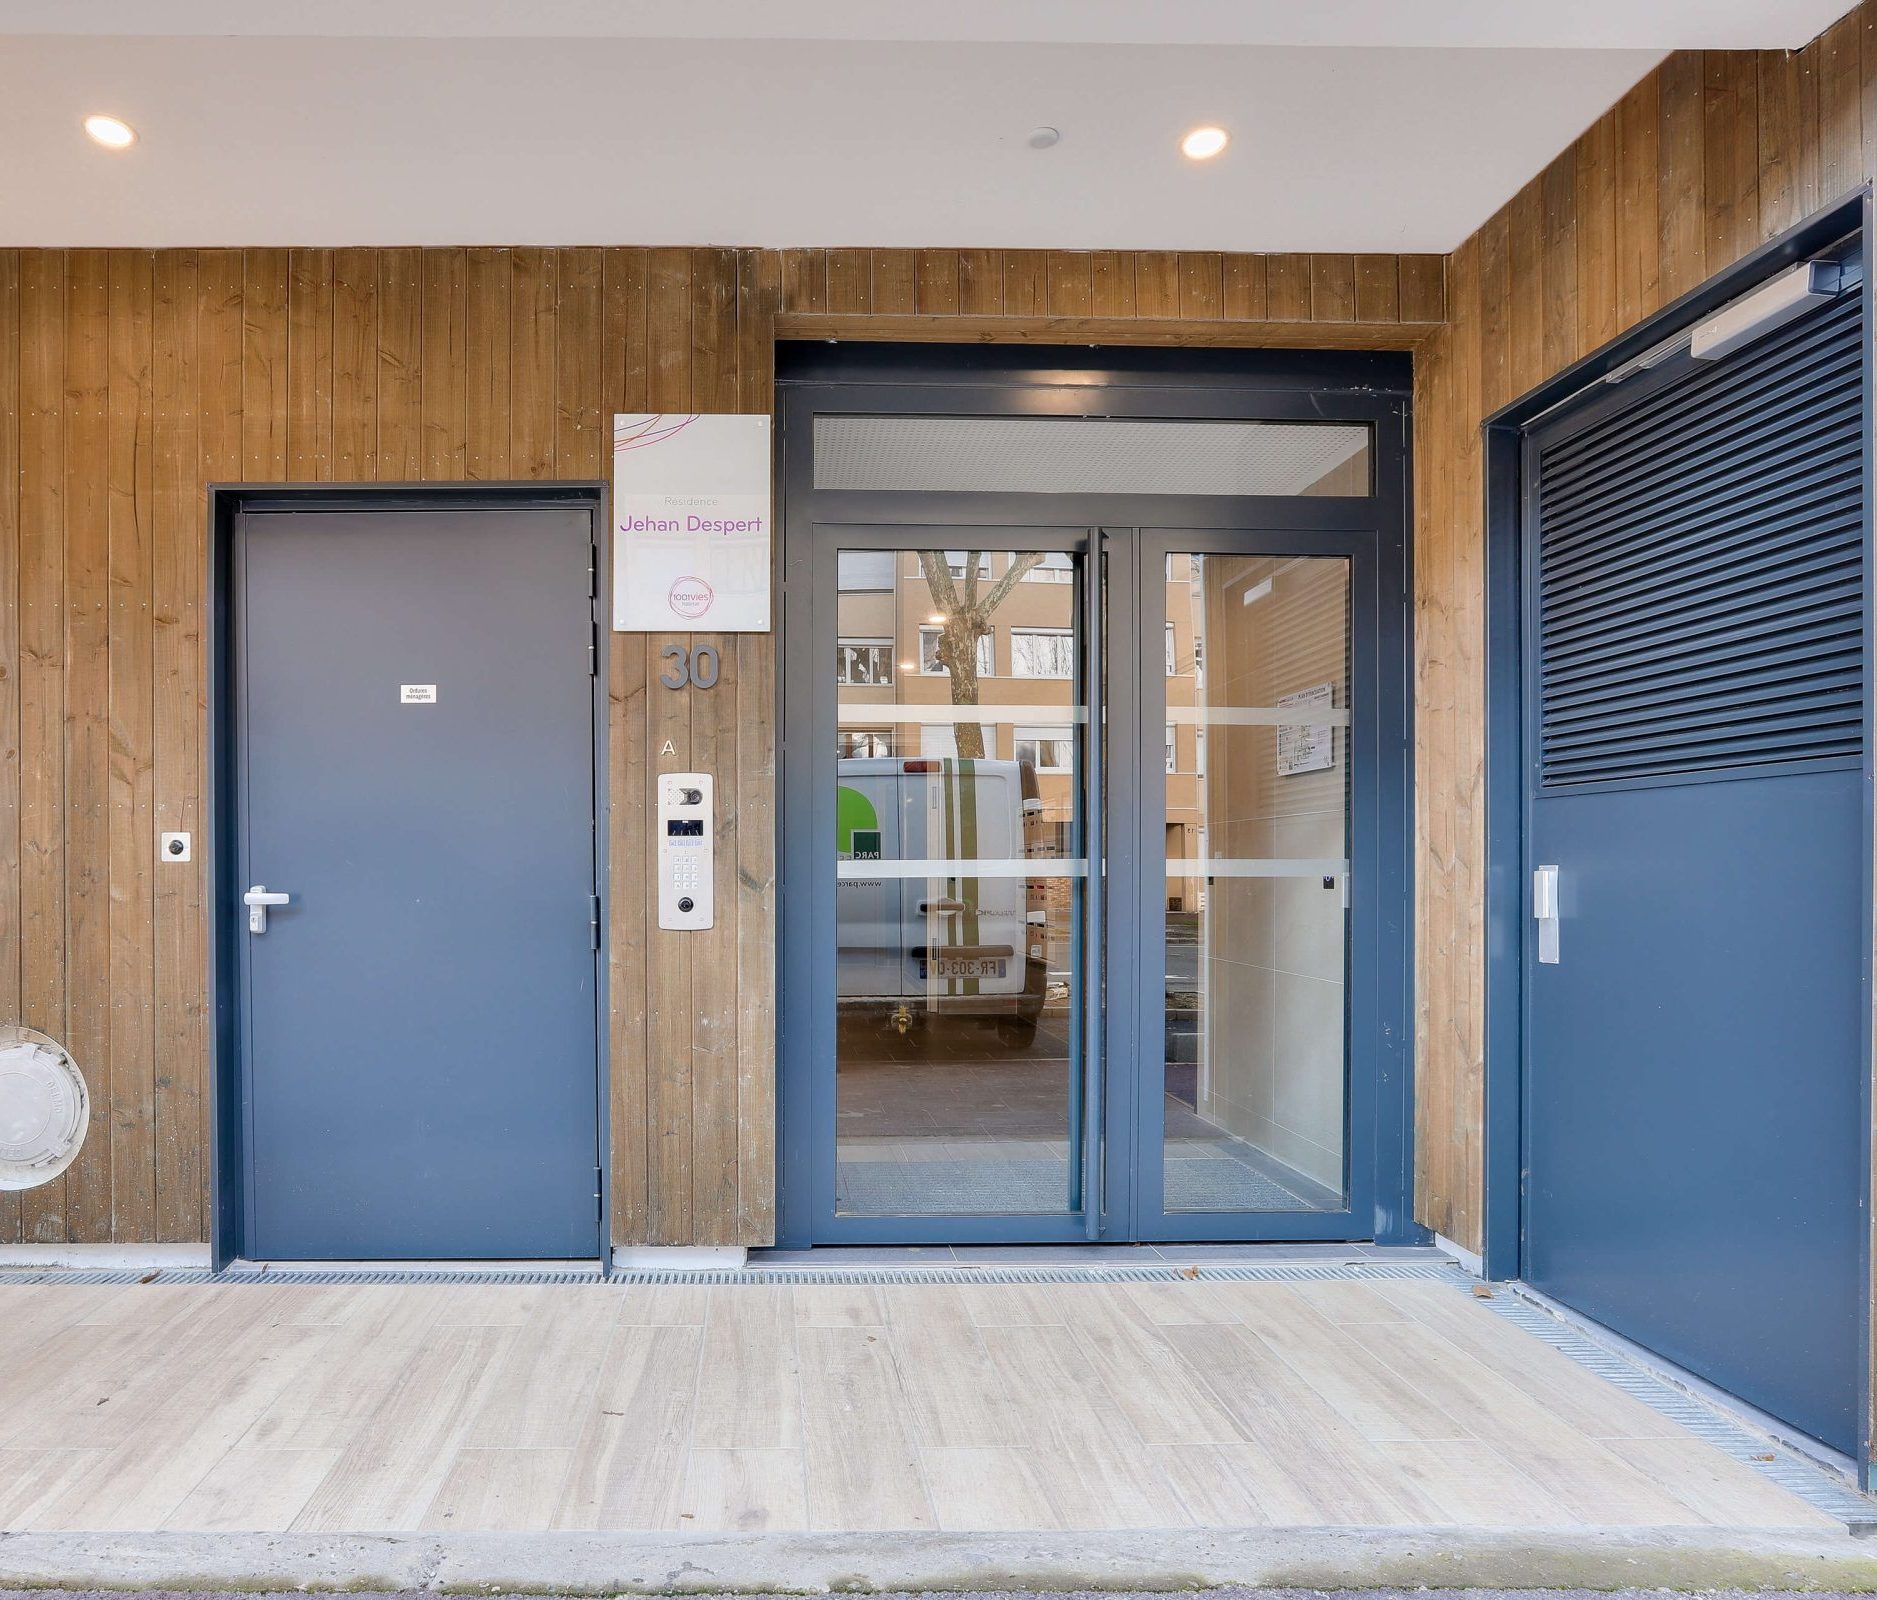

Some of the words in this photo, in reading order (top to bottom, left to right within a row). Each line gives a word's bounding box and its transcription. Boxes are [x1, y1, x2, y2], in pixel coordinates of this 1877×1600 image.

[620, 515, 679, 532] Jehan
[687, 515, 762, 535] Despert
[660, 644, 719, 690] 30
[661, 740, 676, 755] A
